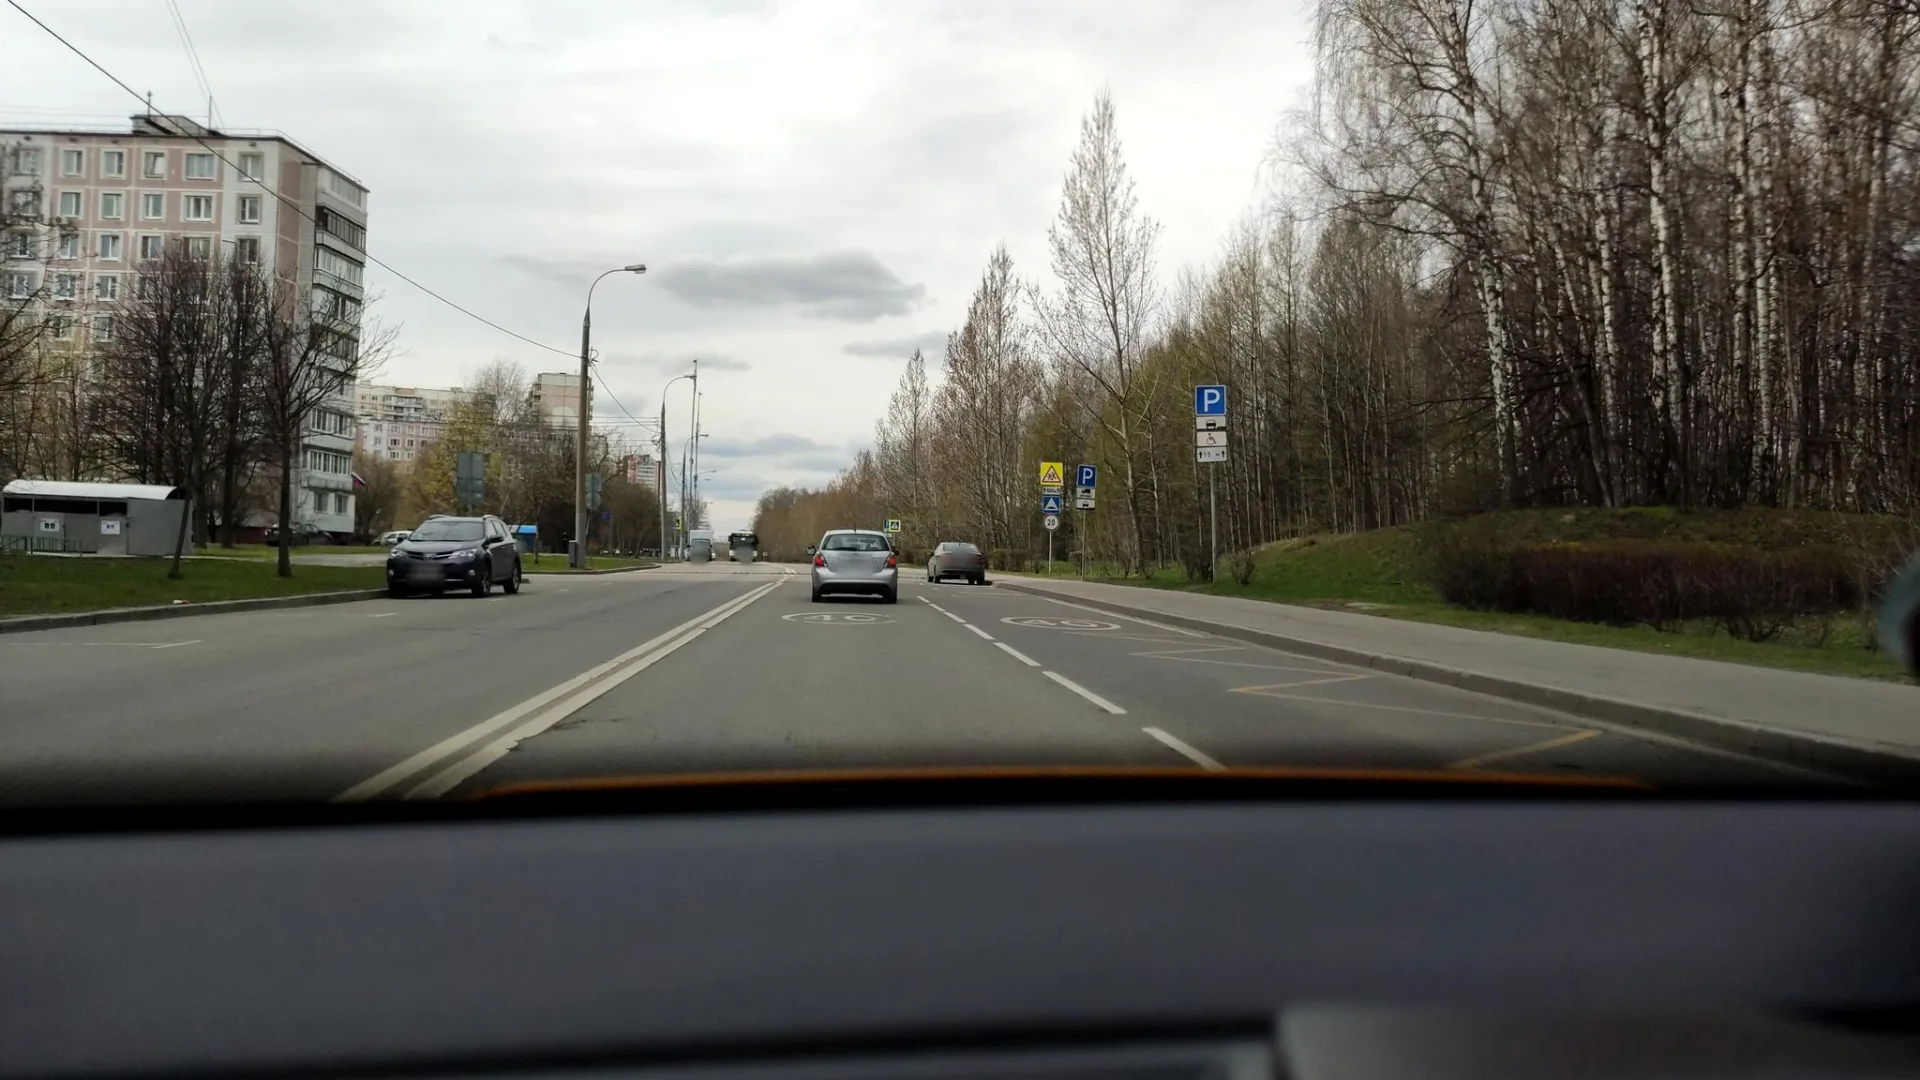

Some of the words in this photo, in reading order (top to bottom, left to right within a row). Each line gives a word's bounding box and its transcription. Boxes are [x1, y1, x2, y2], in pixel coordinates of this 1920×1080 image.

[1203, 388, 1221, 413] P
[1082, 467, 1093, 485] P
[1047, 518, 1056, 526] 20
[1022, 619, 1099, 628] 40
